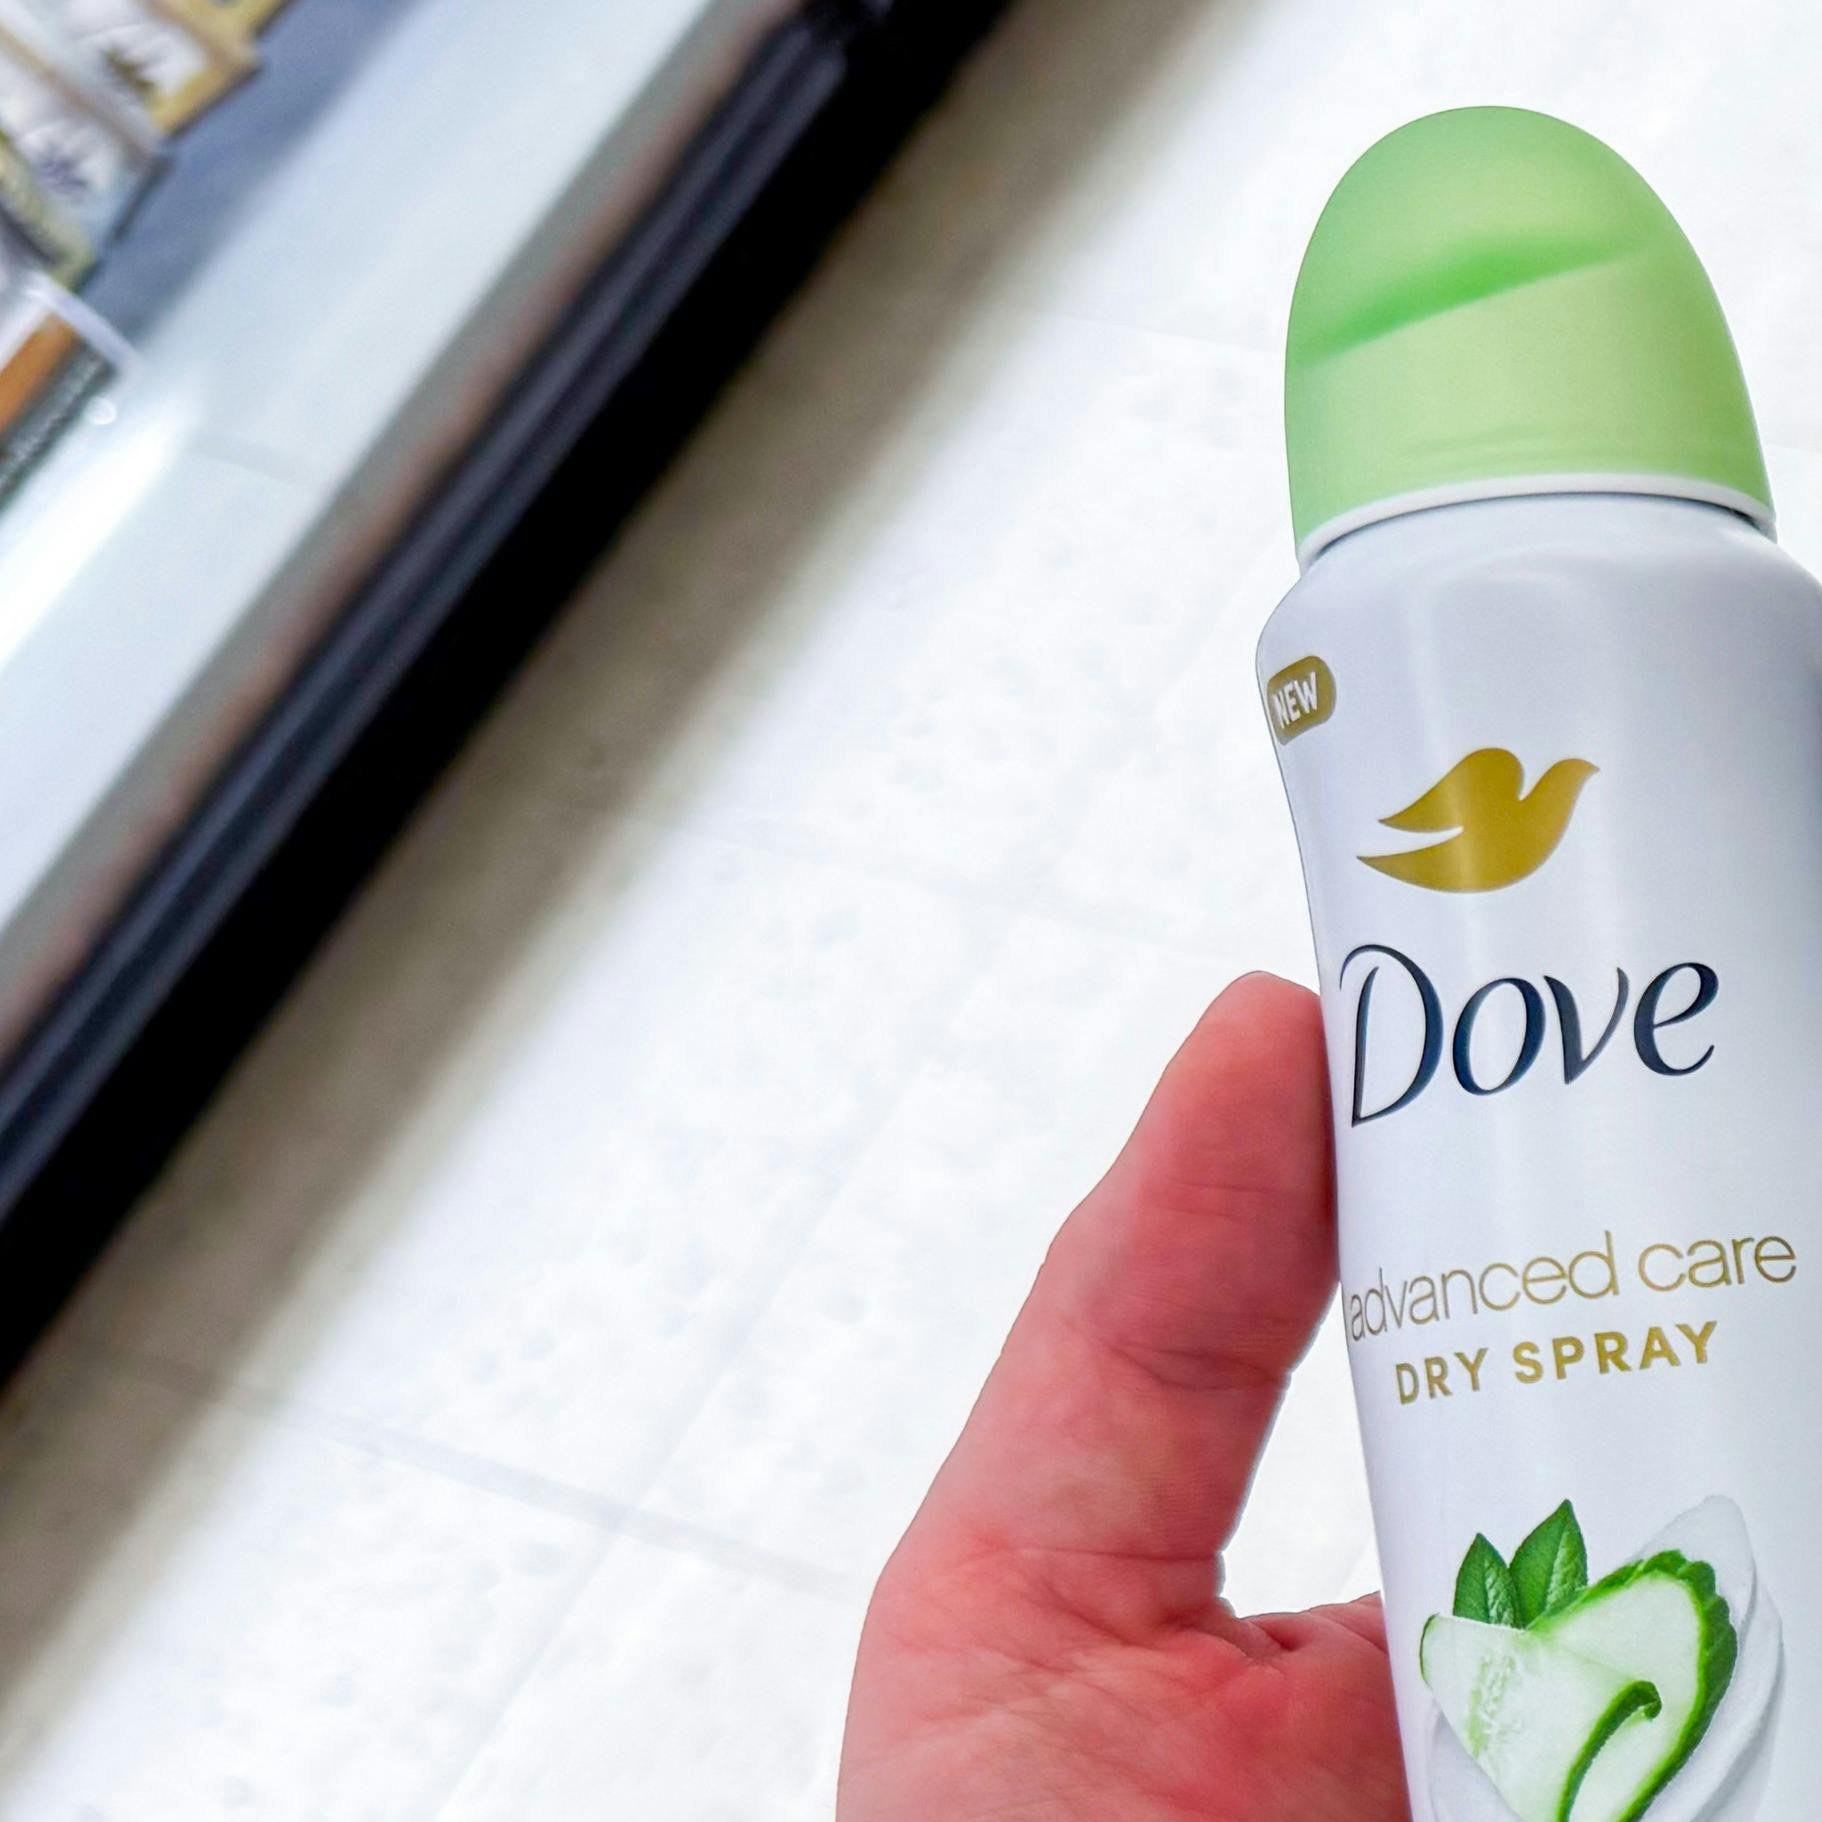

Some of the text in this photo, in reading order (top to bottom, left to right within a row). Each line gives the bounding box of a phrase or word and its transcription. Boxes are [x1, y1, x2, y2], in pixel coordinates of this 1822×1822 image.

[1272, 671, 1318, 730] NEW
[1340, 944, 1719, 1126] Dove
[1349, 1230, 1797, 1341] advanced care
[1395, 1321, 1718, 1405] DRY SPRAY
